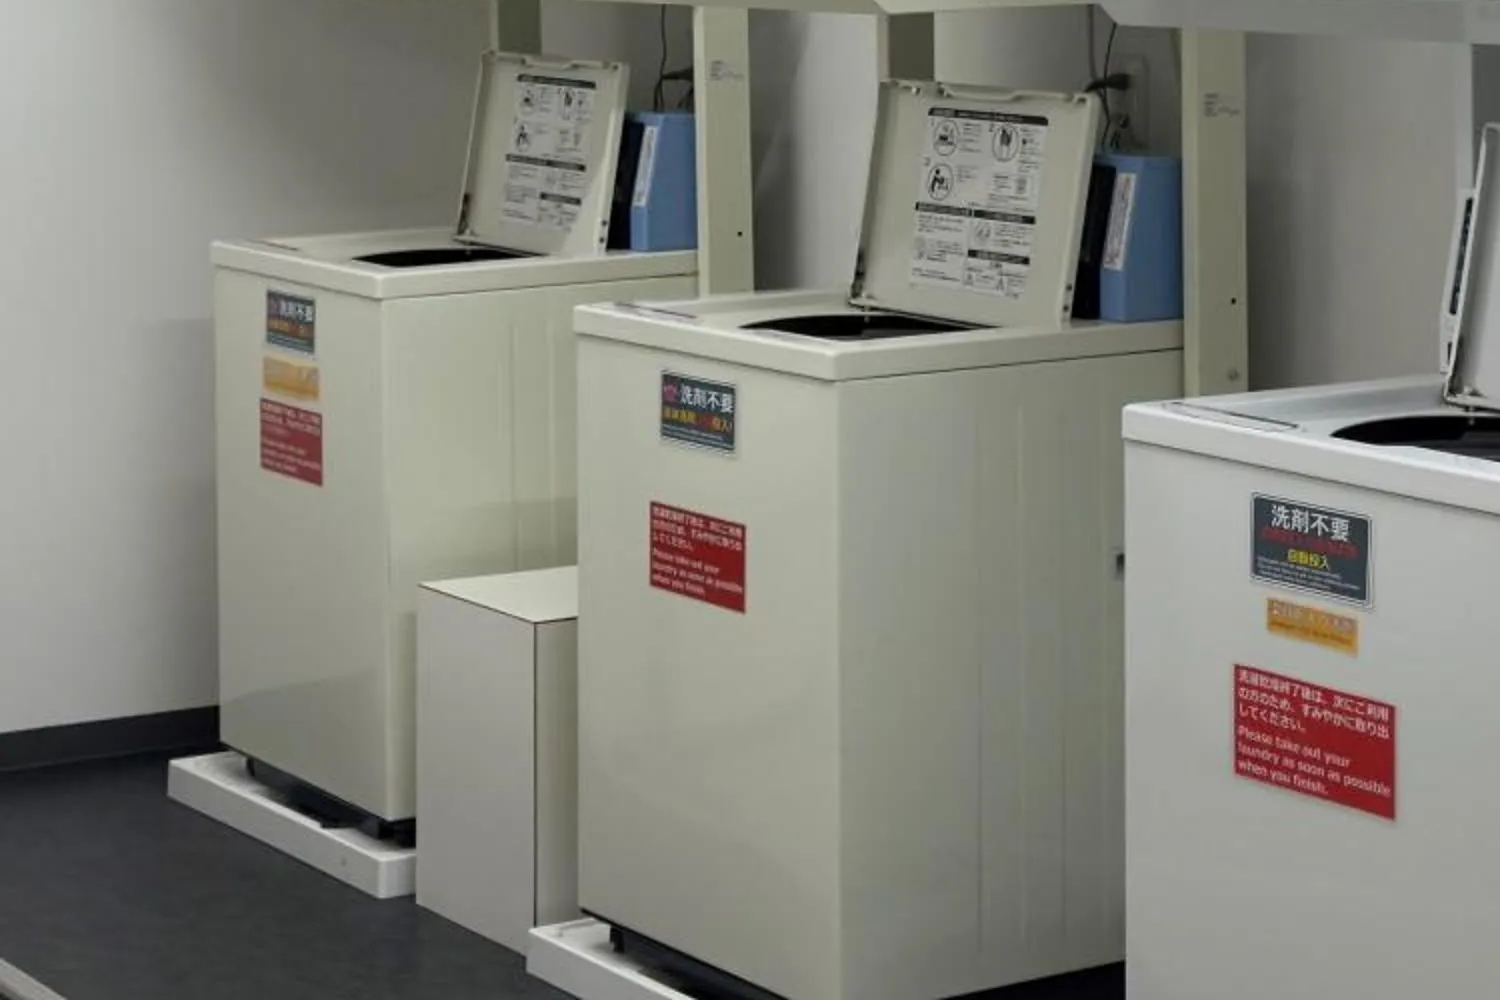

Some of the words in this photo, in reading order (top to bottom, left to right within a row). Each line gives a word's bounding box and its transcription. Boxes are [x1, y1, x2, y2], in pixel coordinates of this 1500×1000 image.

[1271, 504, 1350, 542] 洗剤不要
[1238, 725, 1273, 745] Please
[1275, 737, 1300, 754] take
[1302, 745, 1321, 760] out
[1323, 752, 1351, 768] your
[1237, 742, 1279, 765] laundry
[1281, 756, 1296, 769] as
[1298, 760, 1325, 777] soon
[1327, 769, 1341, 783] as
[1343, 774, 1391, 798] possible
[1238, 759, 1268, 776] when
[1270, 769, 1291, 784] you
